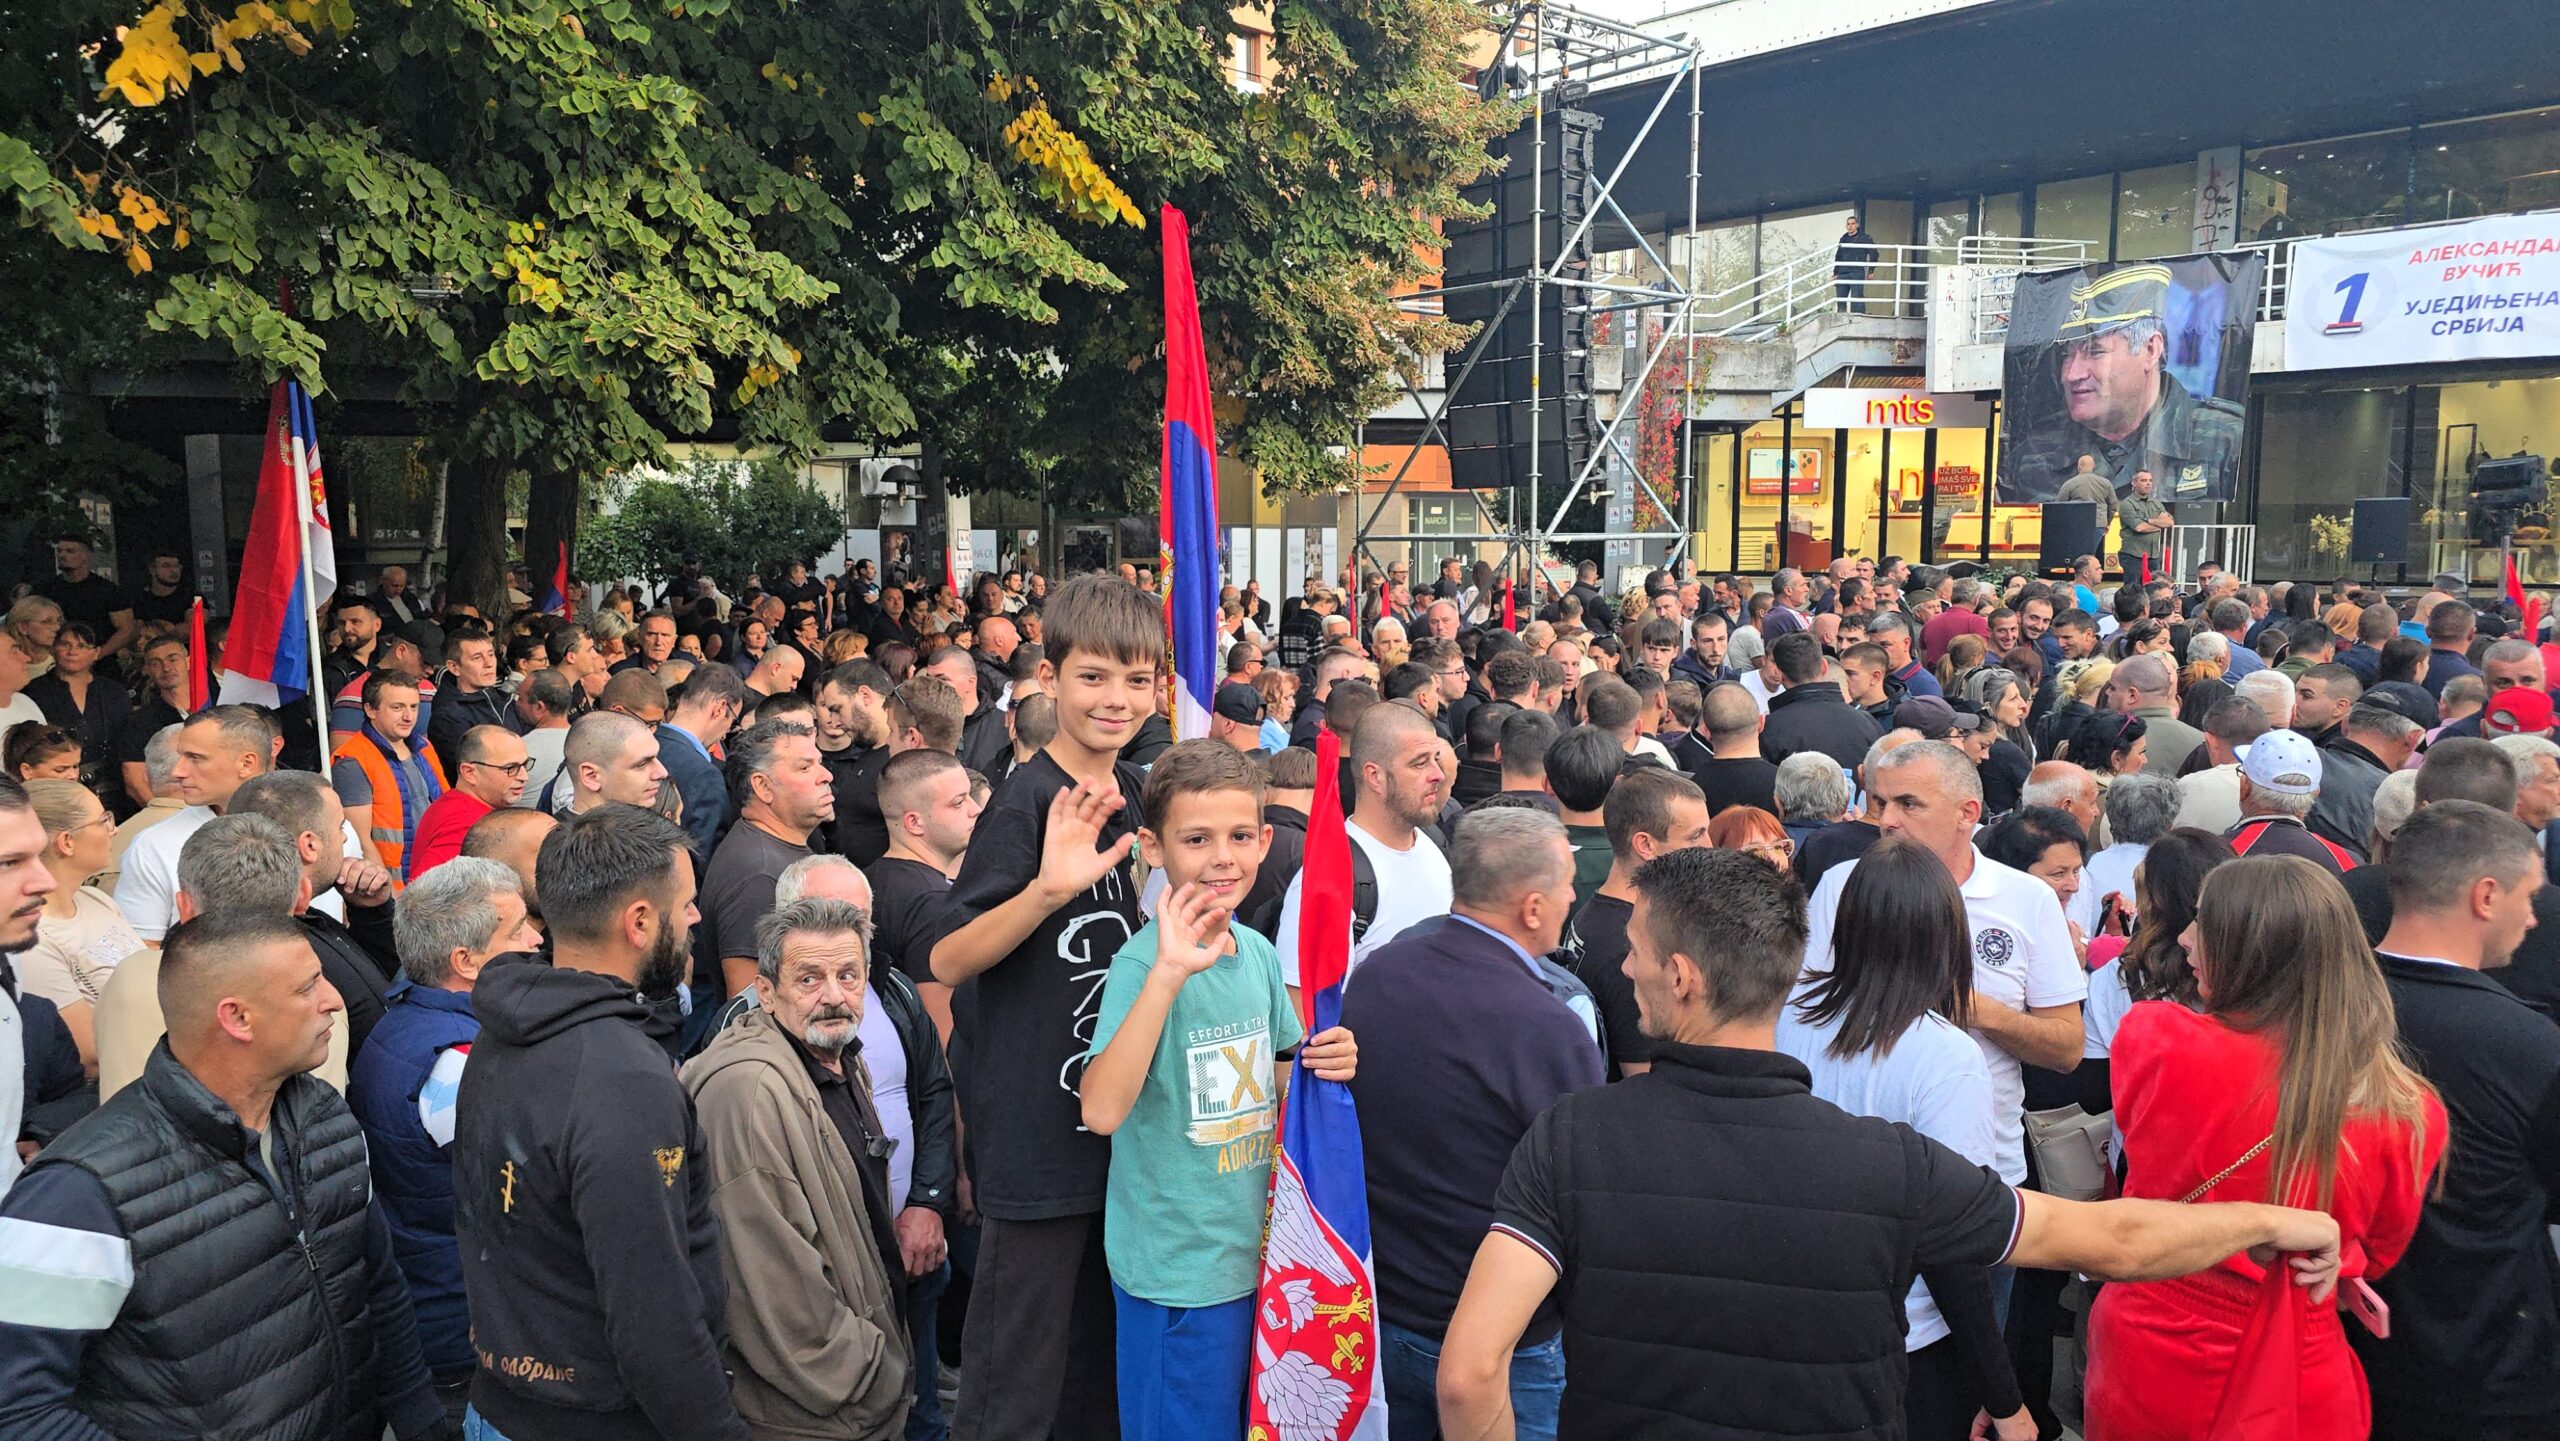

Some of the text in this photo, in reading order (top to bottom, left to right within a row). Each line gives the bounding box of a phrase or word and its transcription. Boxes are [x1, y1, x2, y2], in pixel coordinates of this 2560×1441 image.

[2407, 238, 2560, 266] АЛЕКСАНДА
[2442, 262, 2522, 283] ВУЧИЋ
[2326, 272, 2370, 332] 1
[2404, 290, 2560, 317] УЈЕДИЊЕНА
[2430, 316, 2525, 337] СРБИЈА
[1867, 394, 1935, 425] mts
[1424, 516, 1448, 525] NARCIS
[1188, 1023, 1238, 1043] EFFORT
[1243, 1020, 1250, 1033] X
